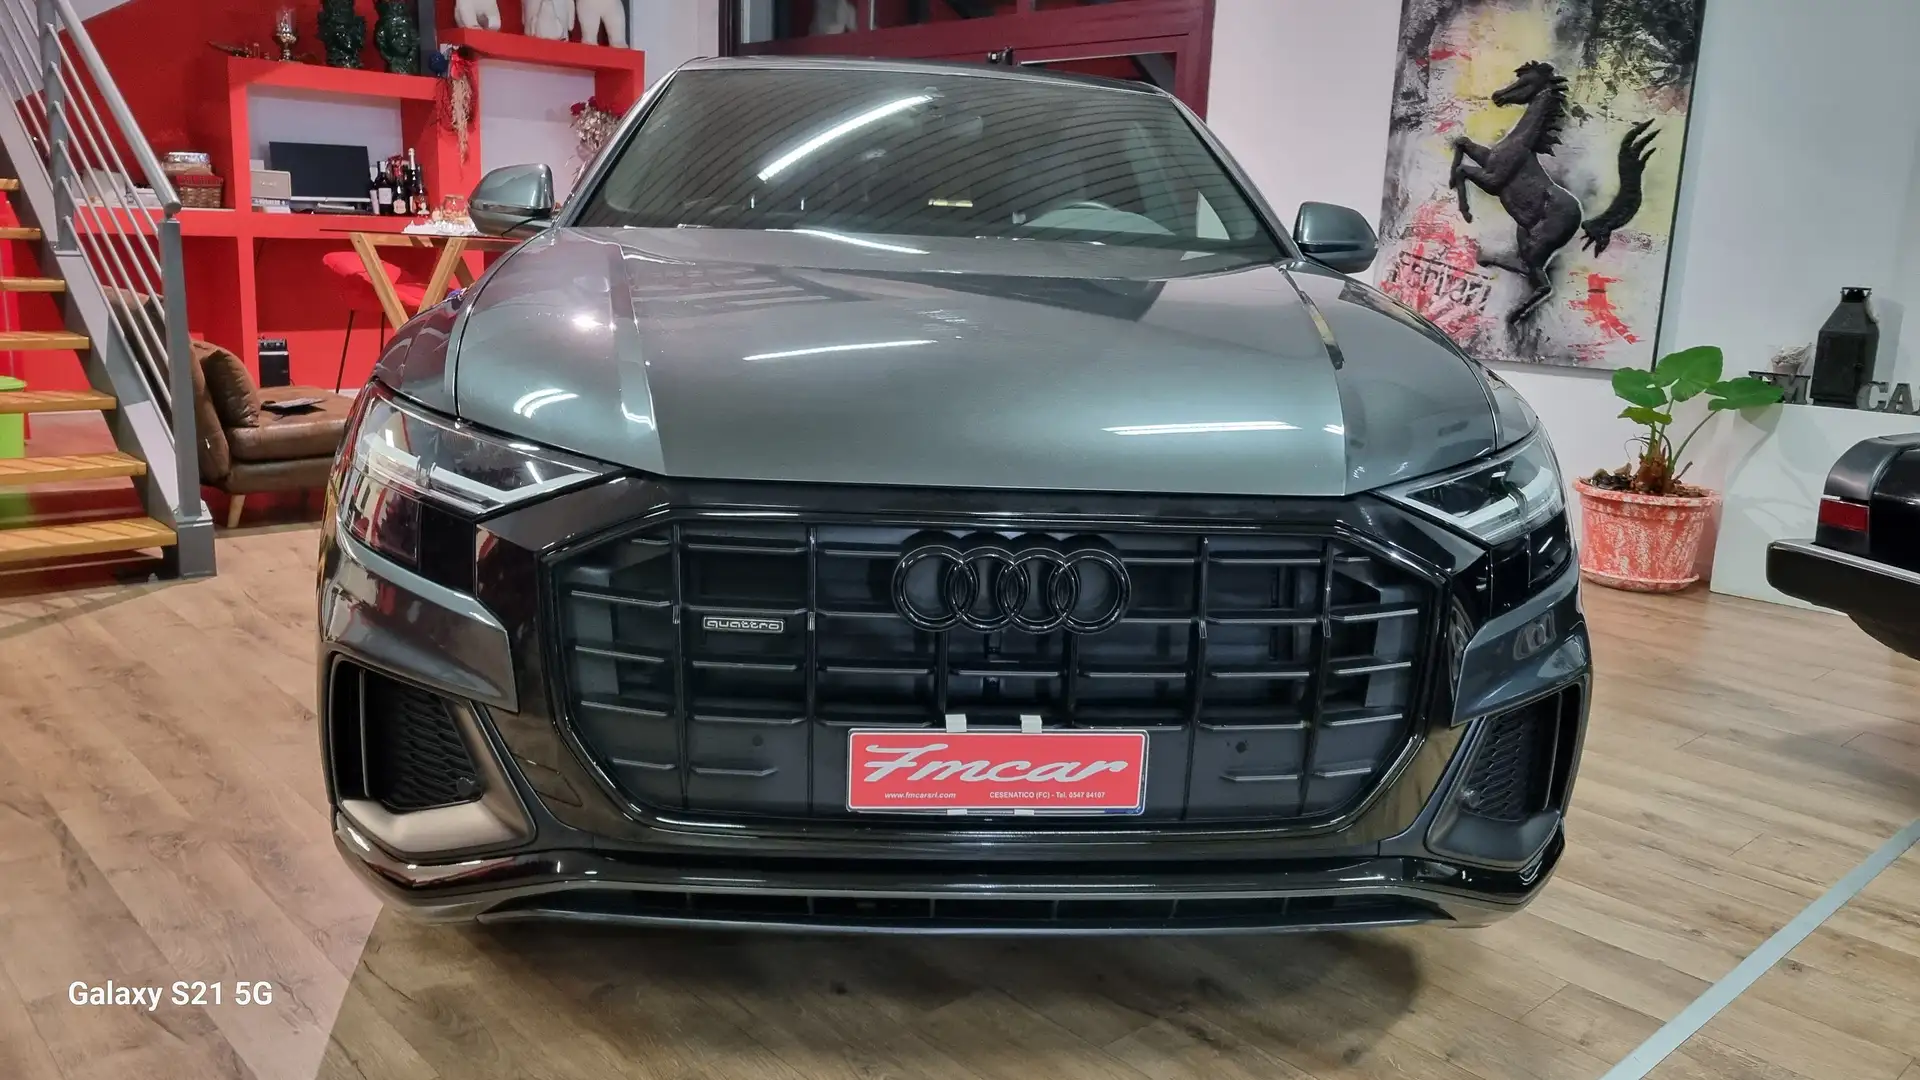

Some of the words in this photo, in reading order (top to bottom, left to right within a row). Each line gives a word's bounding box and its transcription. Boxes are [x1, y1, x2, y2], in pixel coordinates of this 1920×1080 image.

[1857, 380, 1920, 416] CA
[706, 620, 780, 630] quattro
[884, 791, 957, 799] www.fmcarsrl.com
[989, 791, 1035, 799] CESENATICO
[1036, 791, 1051, 800] (FC)
[1055, 791, 1067, 799] Tel.
[1069, 791, 1085, 799] 0547
[1086, 791, 1106, 799] 84107
